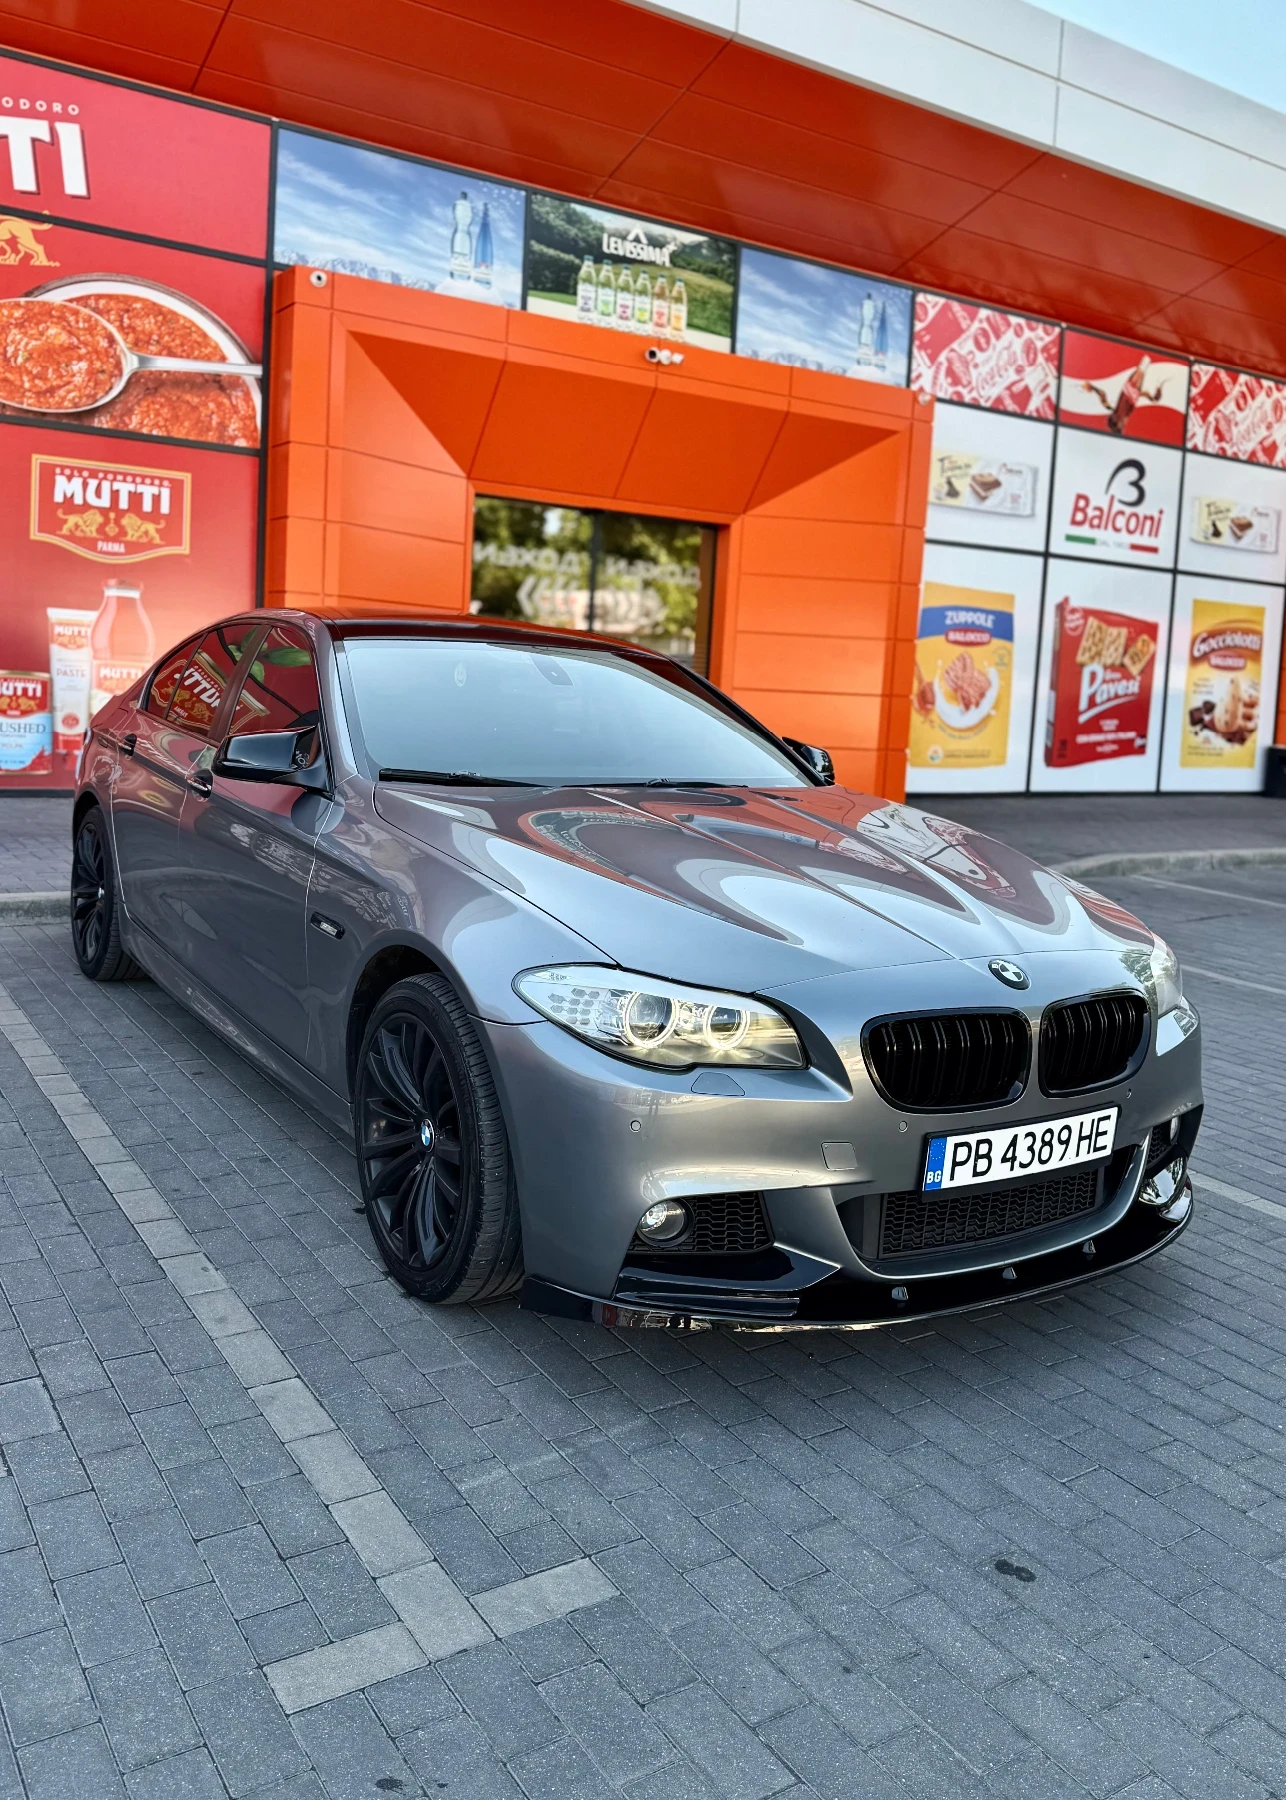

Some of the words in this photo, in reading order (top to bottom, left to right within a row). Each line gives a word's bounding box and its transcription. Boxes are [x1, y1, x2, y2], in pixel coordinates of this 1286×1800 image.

[53, 474, 171, 515] MUTTI
[1069, 492, 1165, 538] Balconi
[97, 540, 126, 553] PARMA
[944, 610, 996, 630] ZUPPOLE
[0, 681, 42, 698] UTTI
[1079, 663, 1141, 712] Pavesi
[949, 1137, 993, 1182] PB
[1000, 1124, 1073, 1173] 4389
[1075, 1114, 1112, 1158] HE
[926, 1170, 942, 1184] BG
